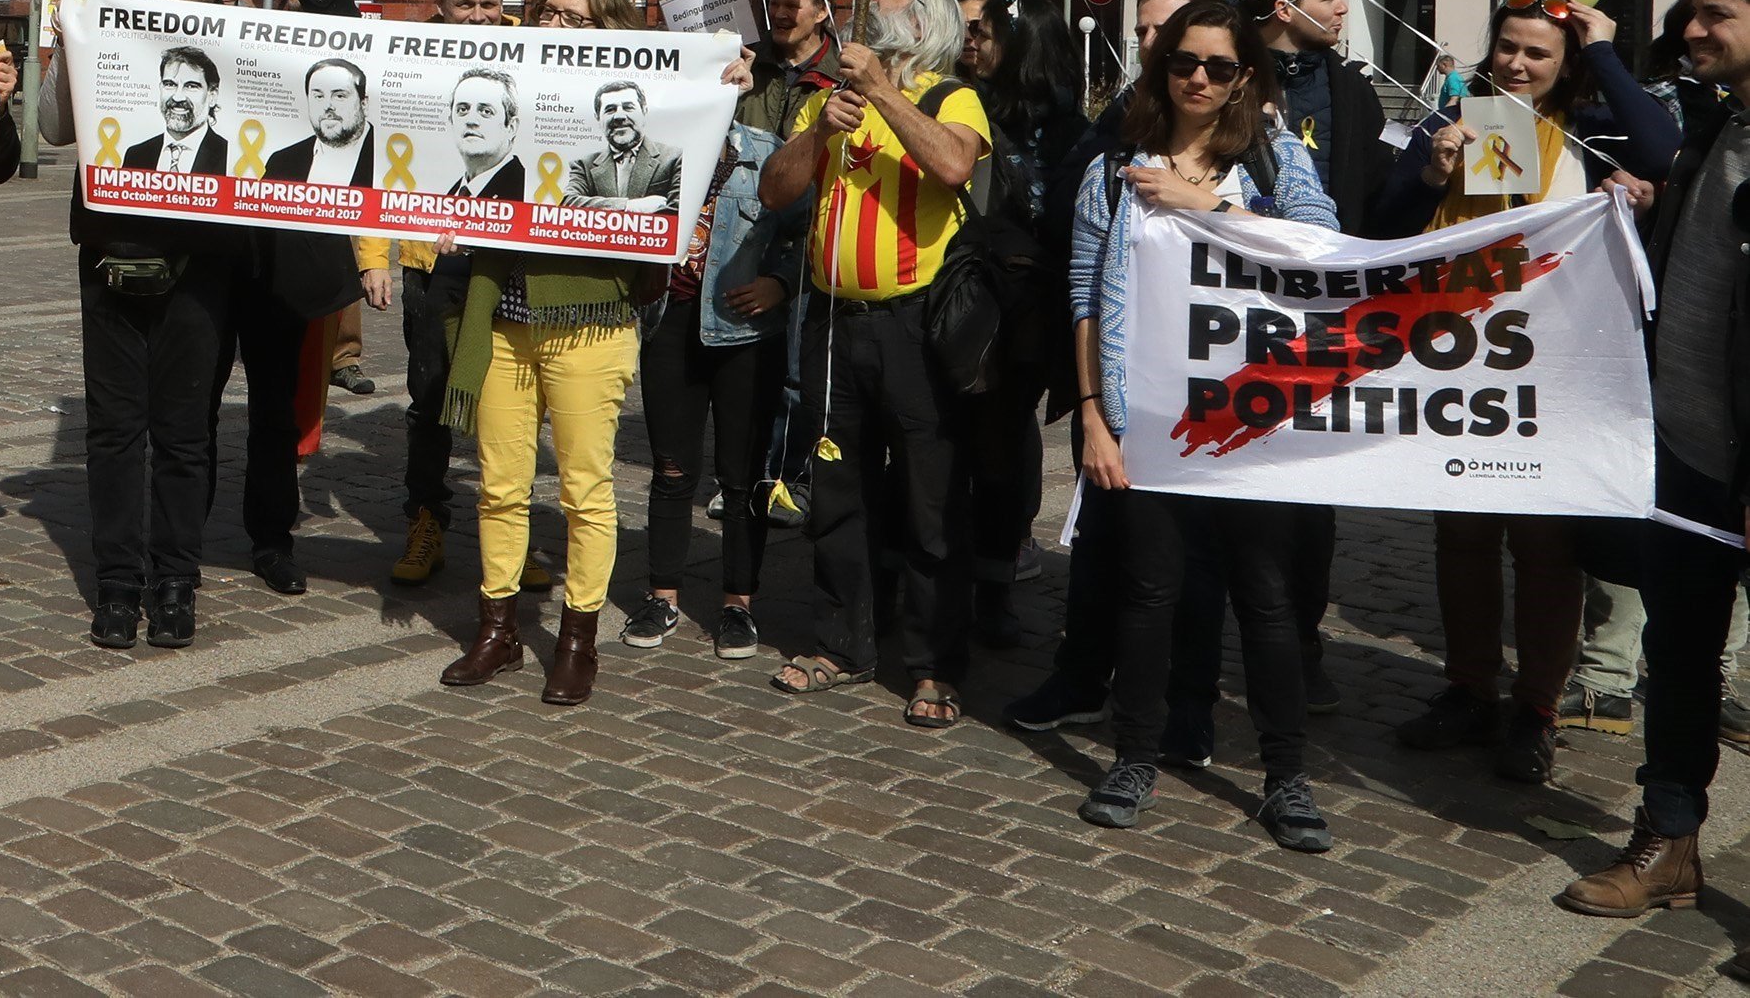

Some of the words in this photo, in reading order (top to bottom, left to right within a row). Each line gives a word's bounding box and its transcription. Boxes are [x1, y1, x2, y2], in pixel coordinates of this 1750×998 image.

[99, 7, 226, 38] FREEDOM
[118, 32, 152, 41] POLITICAL
[154, 35, 188, 44] PRISONER
[200, 38, 220, 47] SPAIN
[239, 21, 373, 52] FREEDOM
[96, 50, 119, 61] Jordi
[388, 36, 525, 63] FREEDOM
[540, 44, 680, 71] FREEDOM
[96, 60, 129, 72] Cuixart
[235, 56, 257, 67] Oriol
[236, 67, 281, 80] Junqueras
[381, 78, 402, 89] Forn
[382, 69, 422, 81] Joaquim
[122, 81, 151, 90] CULTURAL
[535, 90, 560, 102] Jordi
[534, 115, 563, 123] President
[540, 123, 565, 131] peaceful
[534, 130, 568, 139] association
[94, 168, 219, 195] IMPRISONED
[93, 187, 119, 200] since
[121, 189, 164, 203] October
[165, 192, 190, 205] 16th
[191, 196, 218, 207] 2017
[234, 179, 364, 207] IMPRISONED
[233, 199, 259, 211] since
[261, 202, 314, 216] November
[315, 206, 335, 218] 2nd
[337, 209, 361, 221] 2017
[380, 192, 514, 220] IMPRISONED
[379, 212, 406, 224] since
[408, 214, 463, 229] November
[465, 218, 485, 231] 2nd
[487, 221, 512, 233] 2017
[531, 205, 669, 235] IMPRISONED
[529, 226, 558, 239] since
[561, 228, 607, 243] October
[609, 232, 637, 245] 16th
[639, 235, 668, 248] 2017
[1190, 242, 1530, 299] LLIBERTAT
[1187, 303, 1536, 371] PRESOS
[1187, 371, 1539, 438] POLÍTICS!
